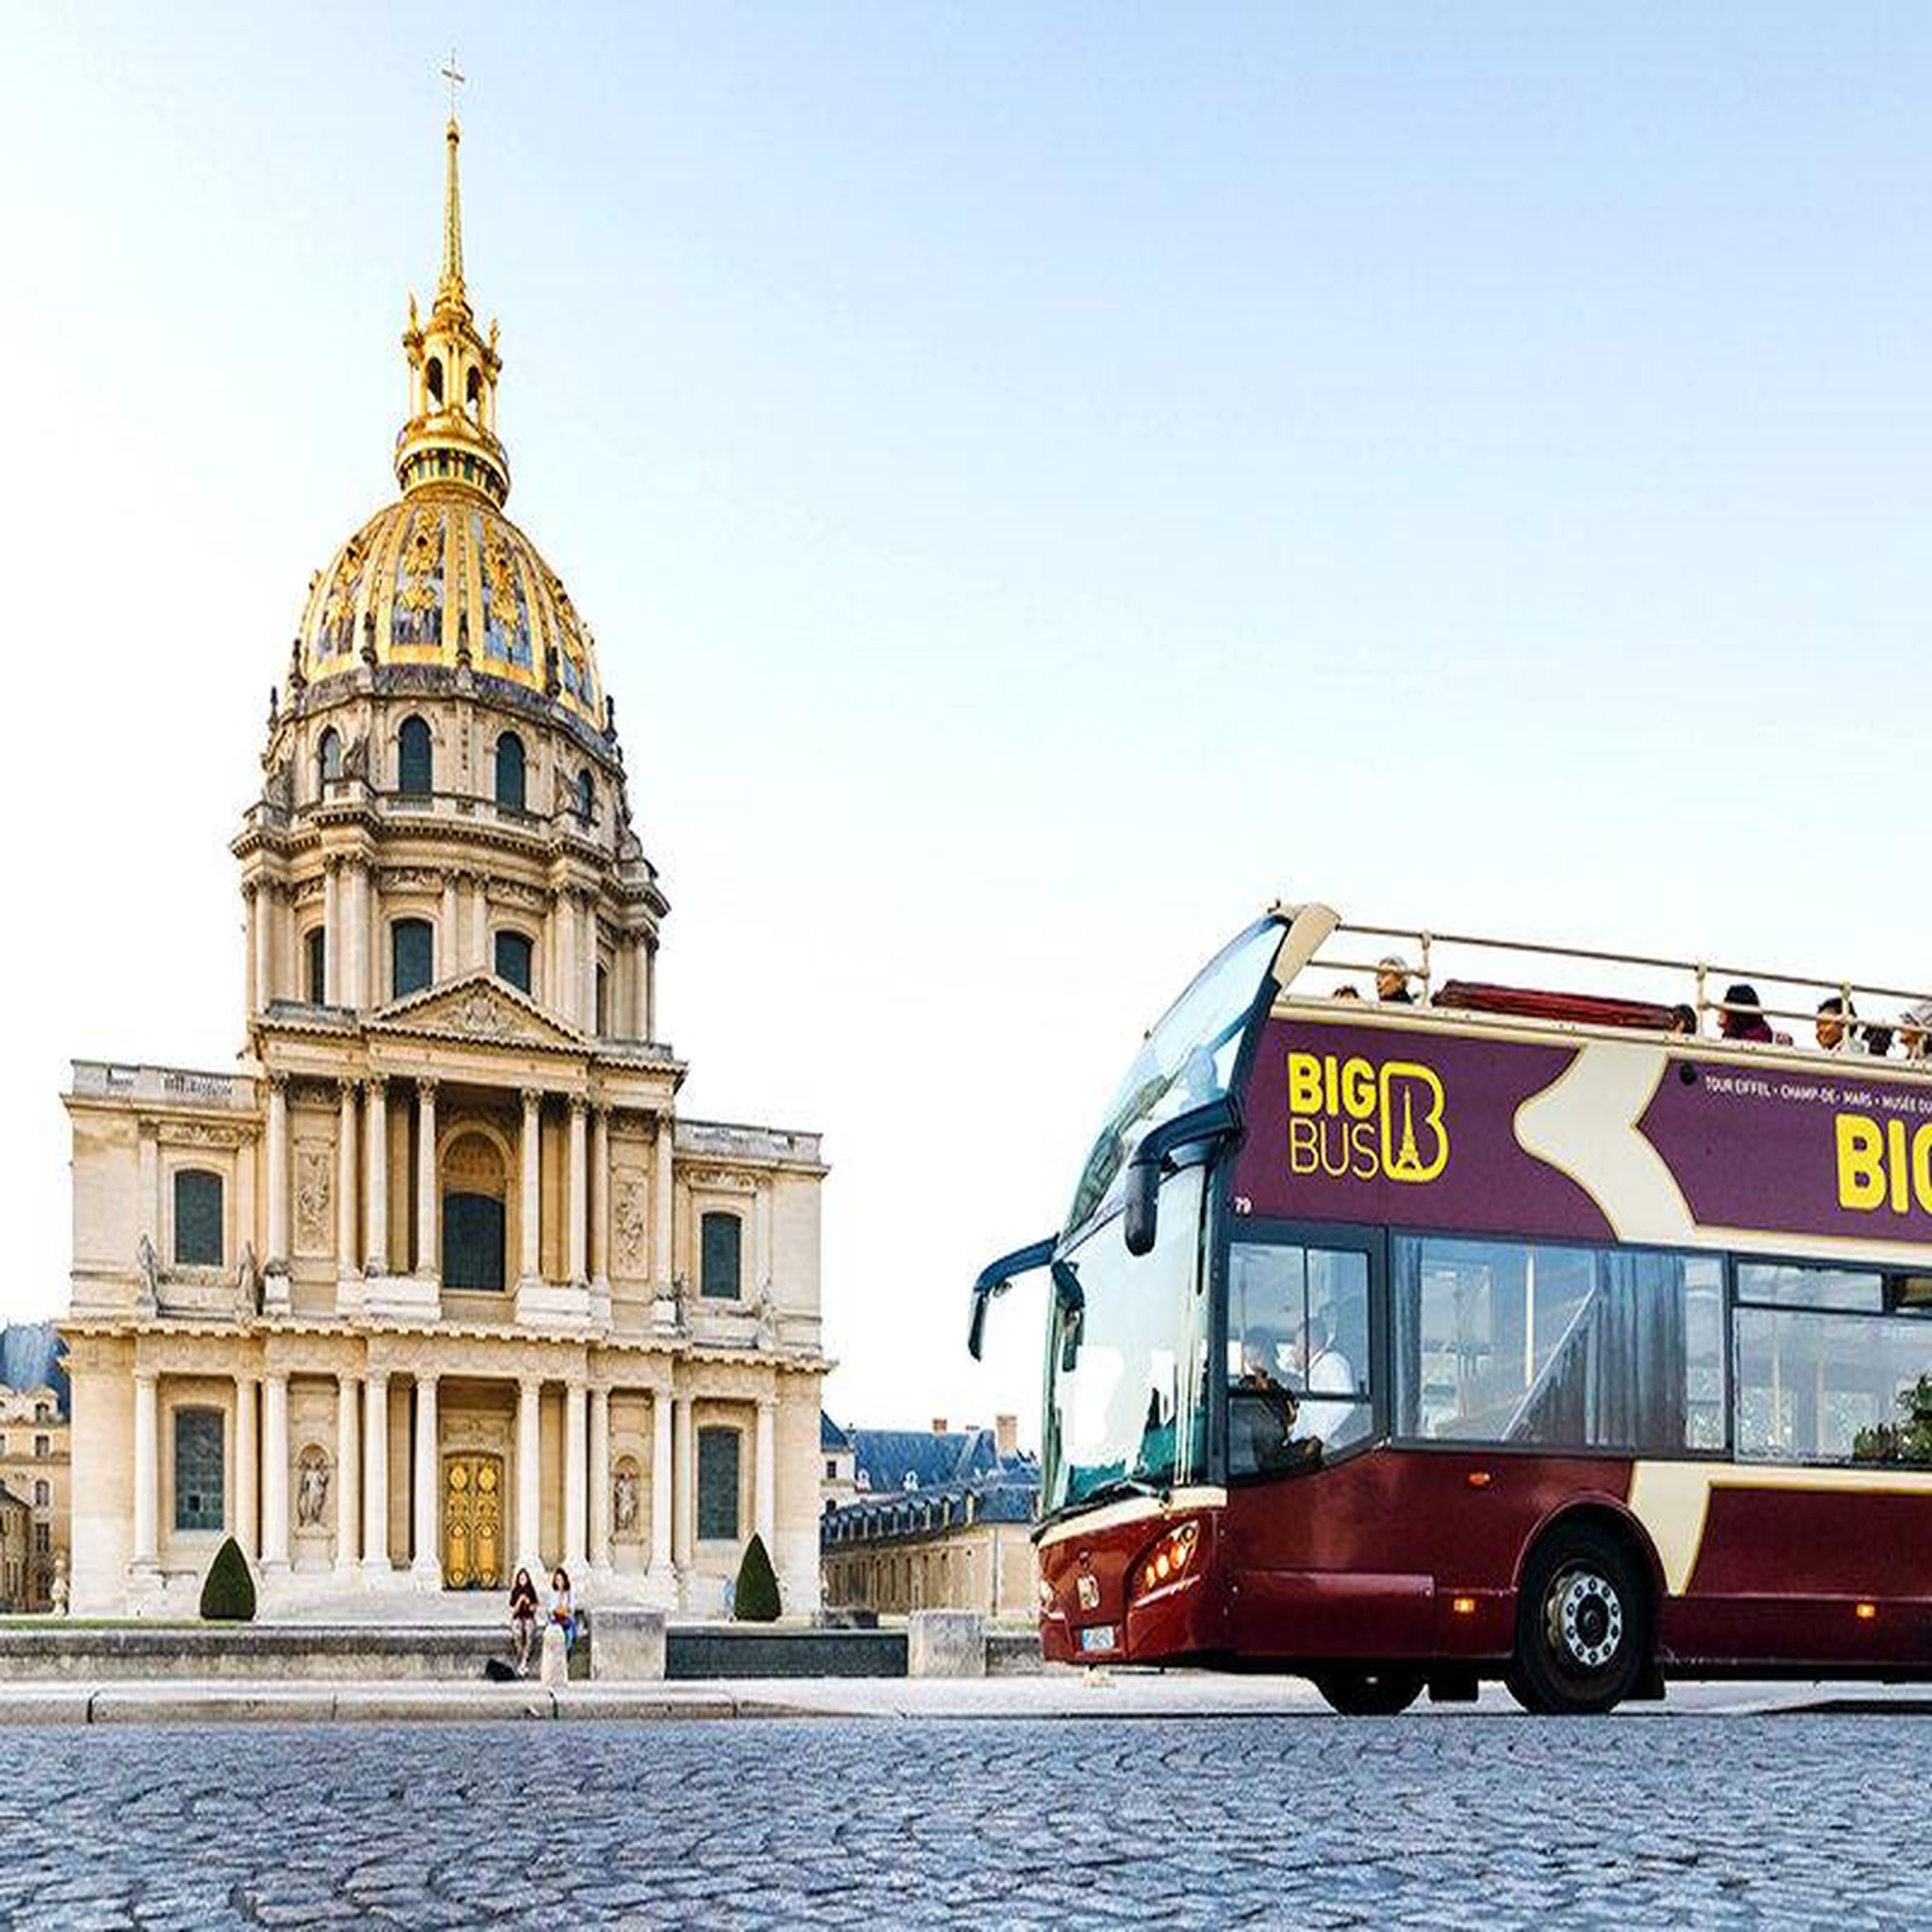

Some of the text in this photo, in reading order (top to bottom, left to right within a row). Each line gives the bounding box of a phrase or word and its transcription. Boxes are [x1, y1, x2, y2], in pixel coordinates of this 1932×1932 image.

[1288, 1052, 1377, 1119] BIG
[1706, 1075, 1733, 1093] TOUR
[1736, 1078, 1772, 1098] EIFFEL
[1290, 1117, 1378, 1178] BUS
[1235, 1196, 1252, 1214] 79
